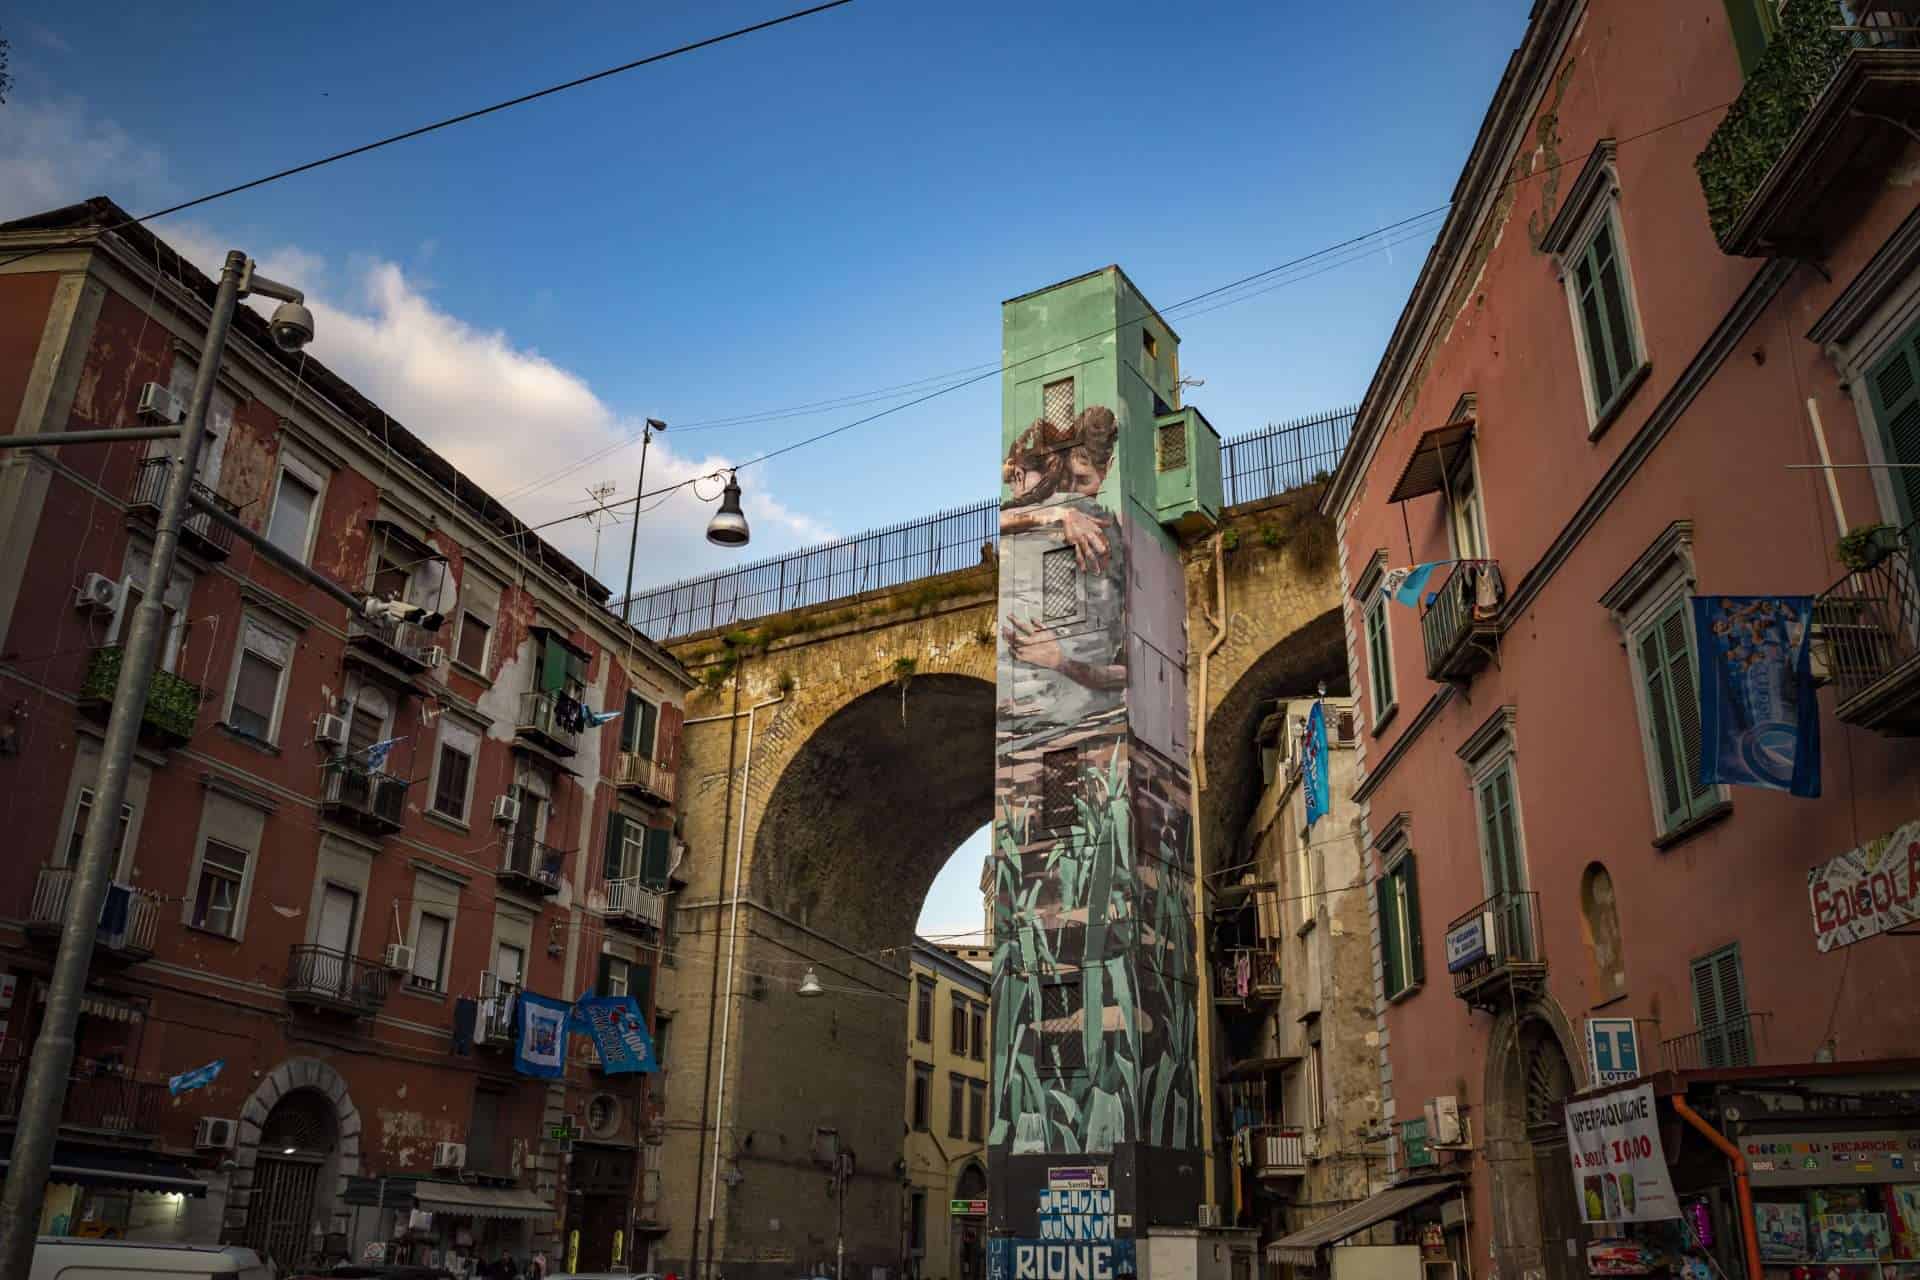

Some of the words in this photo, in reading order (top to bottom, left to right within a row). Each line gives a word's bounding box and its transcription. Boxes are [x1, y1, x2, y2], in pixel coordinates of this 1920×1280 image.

[1601, 1071, 1637, 1081] LOTTO
[1611, 1134, 1651, 1165] 10,00
[1747, 1143, 1821, 1155] GIOCATLI
[1016, 1245, 1113, 1280] RIONE
